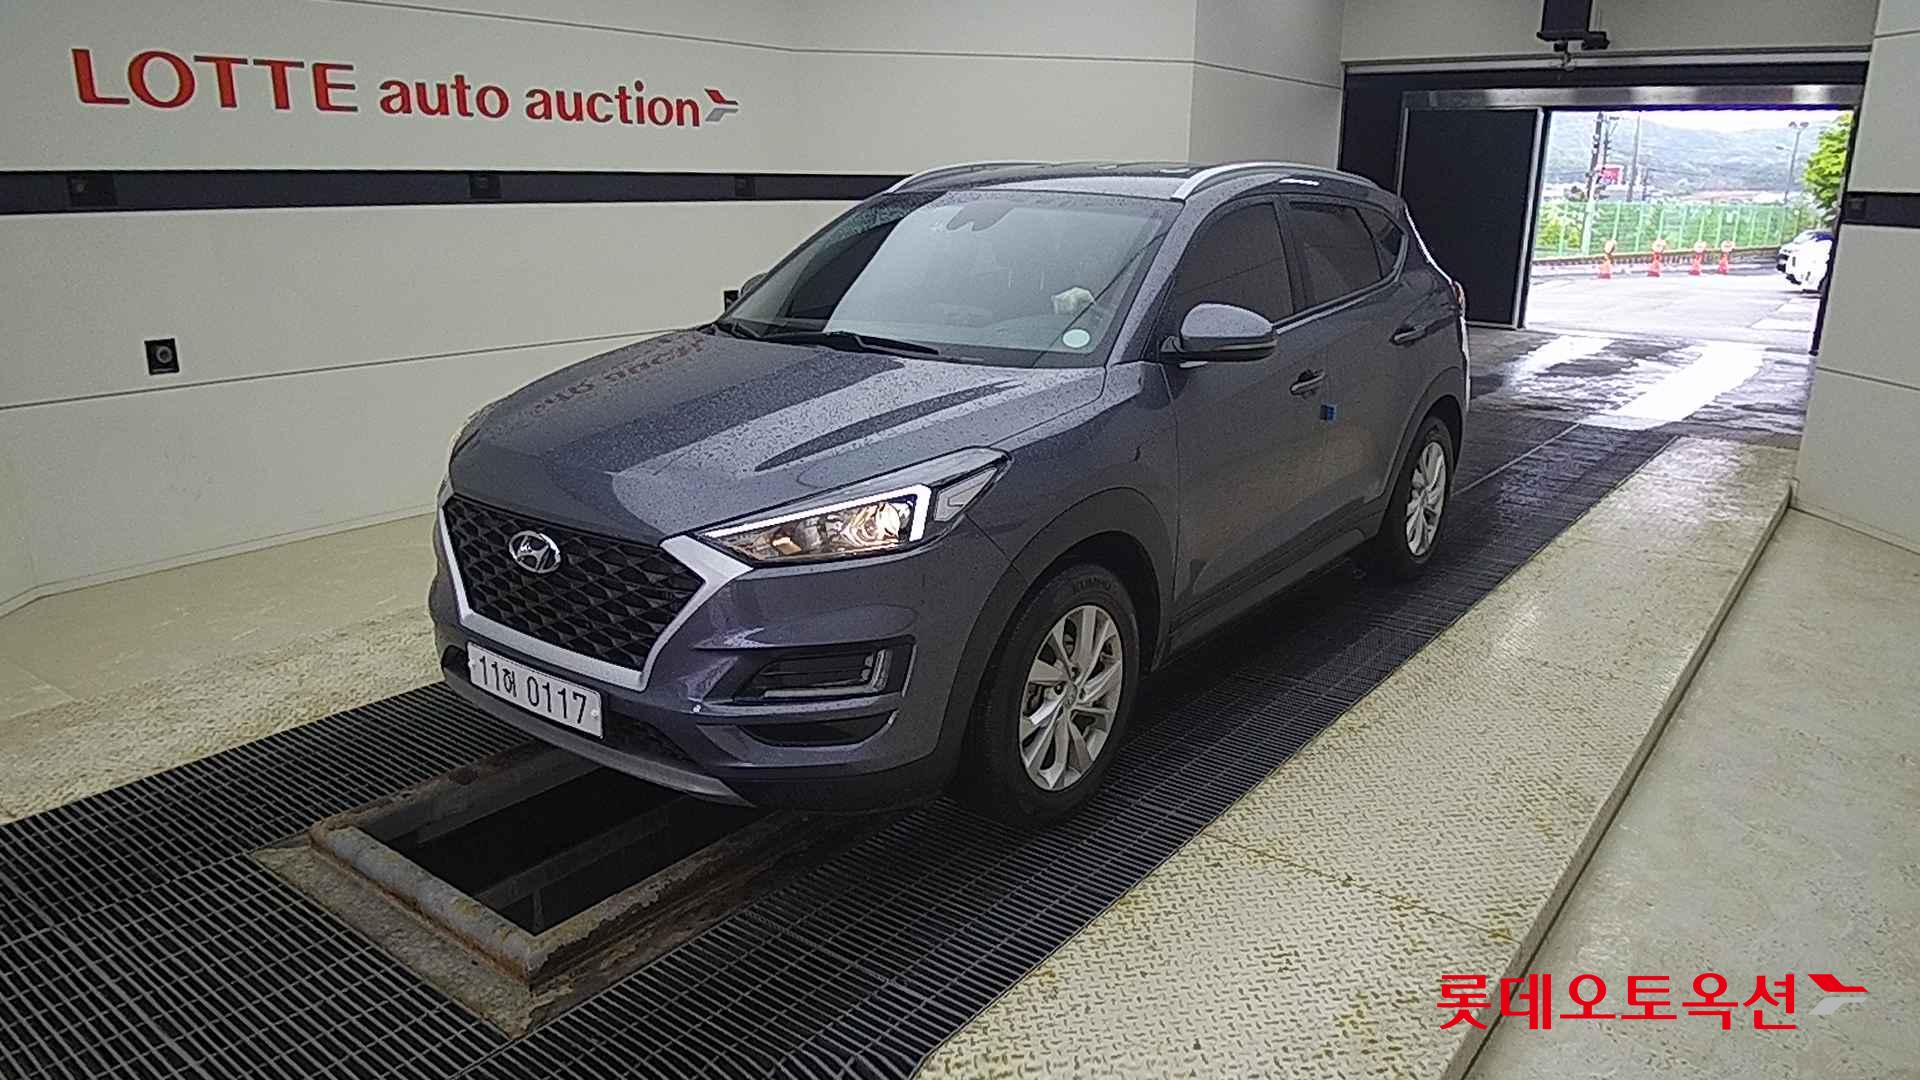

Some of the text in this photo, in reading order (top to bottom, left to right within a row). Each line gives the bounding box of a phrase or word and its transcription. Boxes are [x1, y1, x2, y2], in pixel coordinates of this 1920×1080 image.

[71, 48, 700, 127] LOTTE auto auction
[480, 655, 587, 724] 11허 0117
